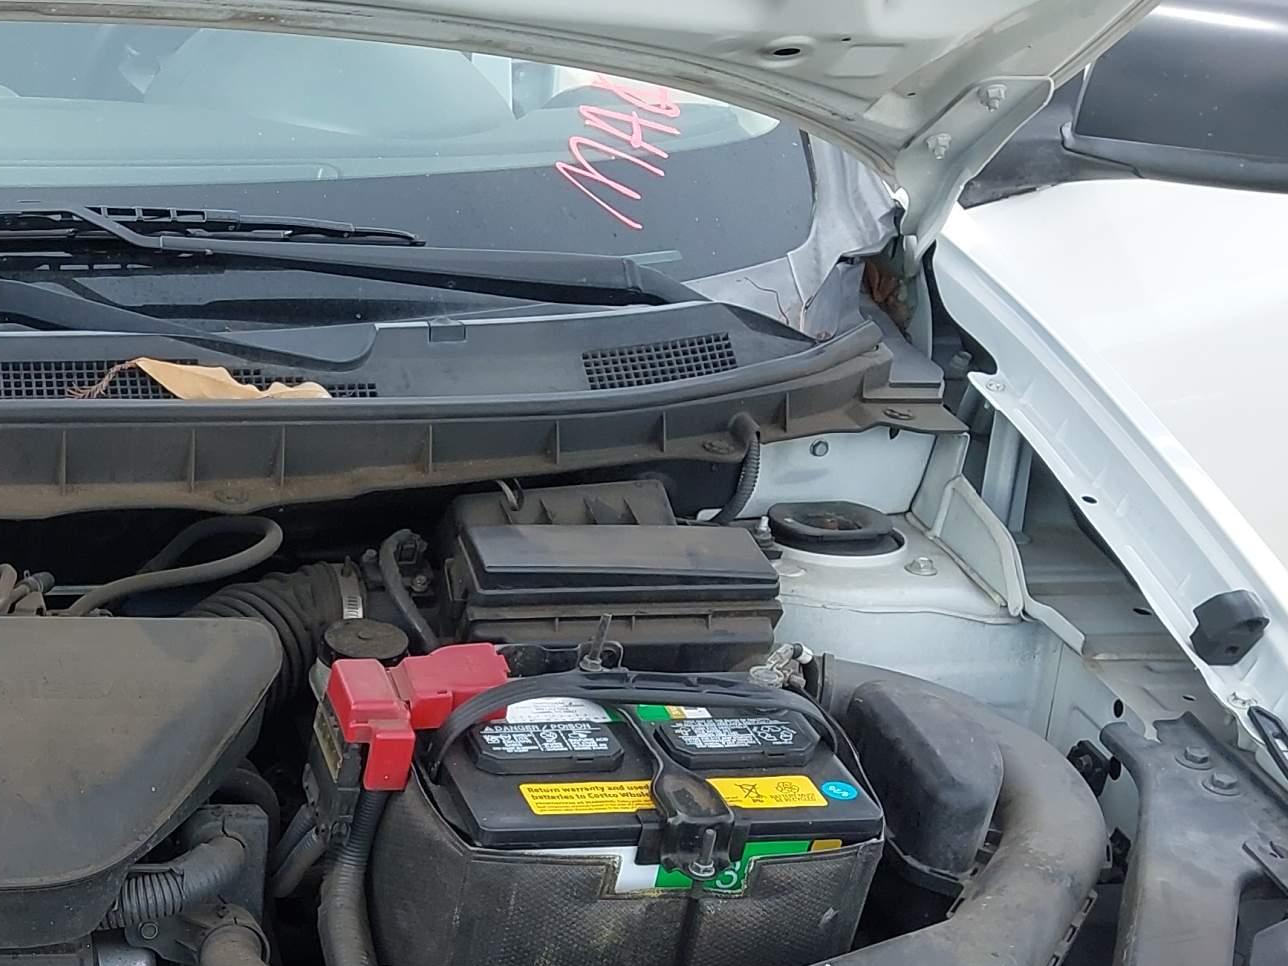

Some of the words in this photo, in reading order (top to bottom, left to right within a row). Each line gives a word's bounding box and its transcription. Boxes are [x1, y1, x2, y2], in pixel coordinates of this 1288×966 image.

[494, 723, 540, 732] DANGER
[549, 722, 592, 731] POISON
[526, 786, 561, 794] Return
[562, 785, 605, 794] warranty
[530, 792, 575, 801] batteries
[576, 792, 586, 800] to
[587, 791, 618, 800] Costco
